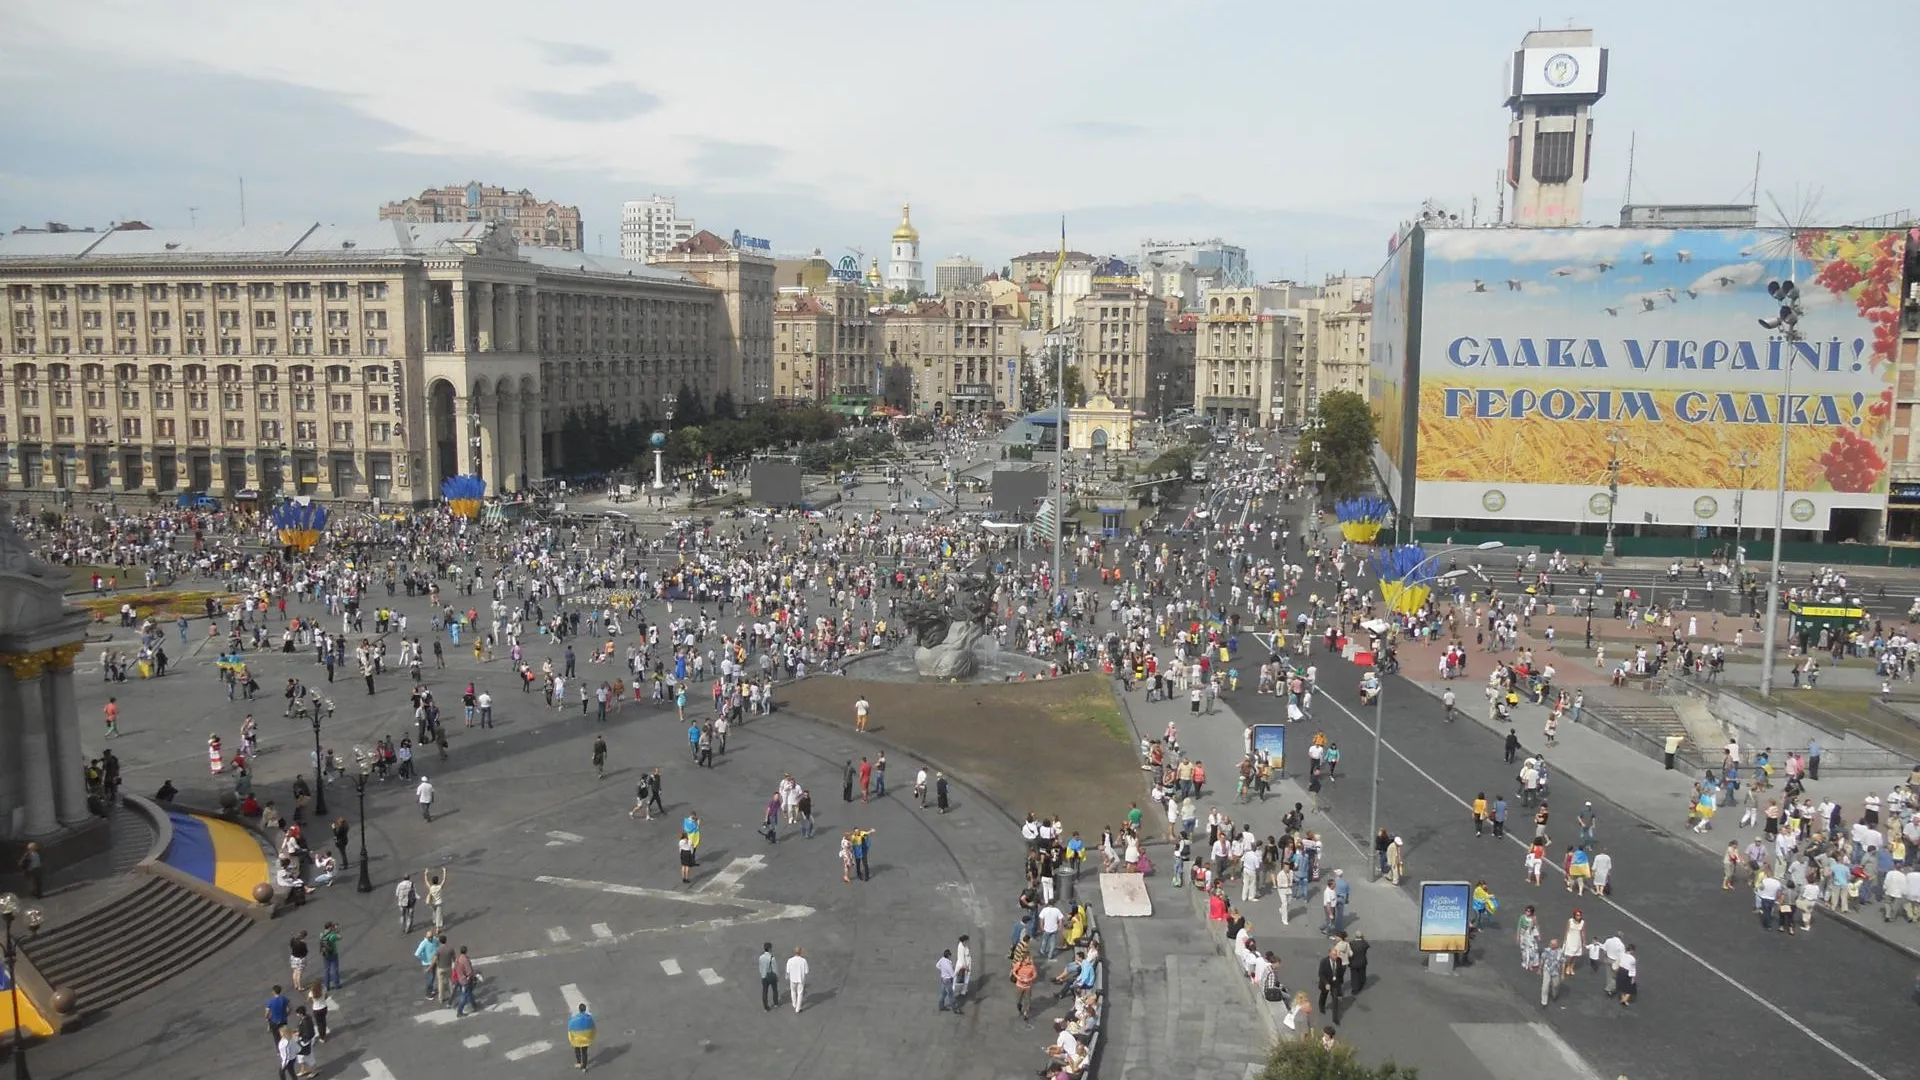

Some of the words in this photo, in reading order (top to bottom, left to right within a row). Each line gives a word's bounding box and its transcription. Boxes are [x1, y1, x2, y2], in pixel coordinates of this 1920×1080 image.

[1447, 335, 1608, 368] СЛАВА
[1623, 335, 1864, 373] УКРАЇНІ!
[1444, 387, 1661, 421] ГЕРОЯМ
[1674, 391, 1864, 425] СЛАВА!
